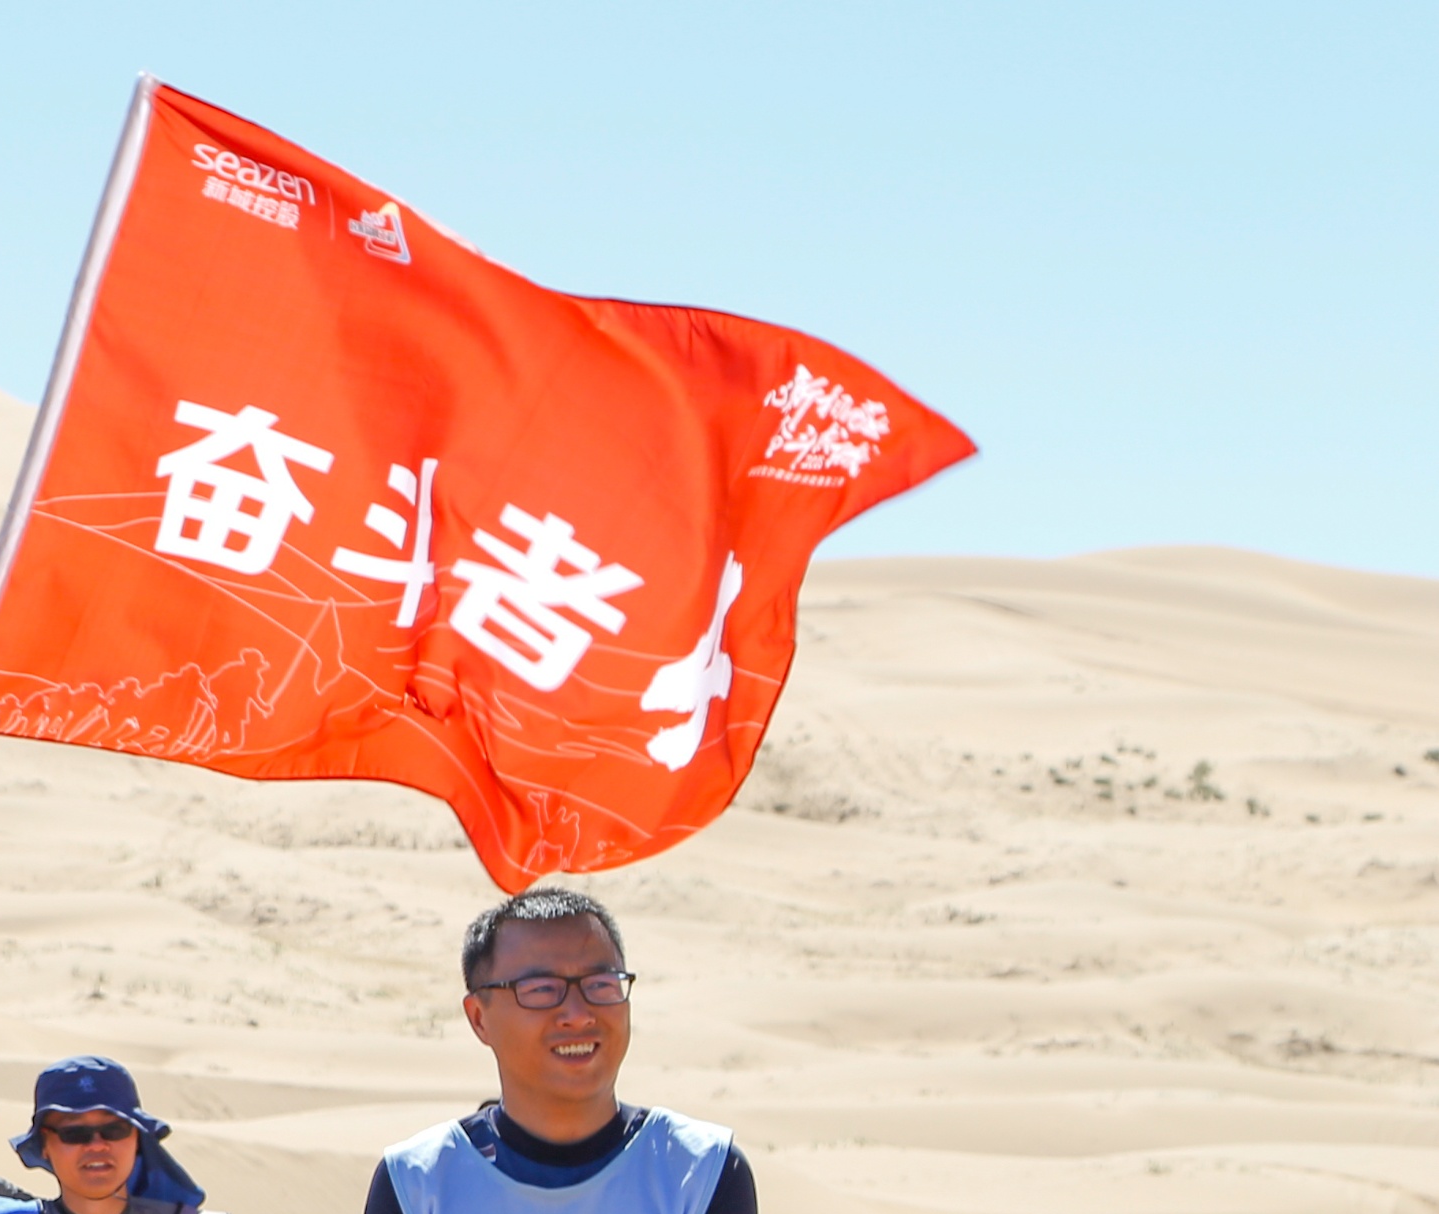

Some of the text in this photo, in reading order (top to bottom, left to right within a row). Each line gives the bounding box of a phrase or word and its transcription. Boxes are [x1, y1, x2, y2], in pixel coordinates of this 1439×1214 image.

[191, 143, 316, 206] seazen
[201, 175, 301, 231] 新城控股
[154, 399, 645, 692] 奋斗者
